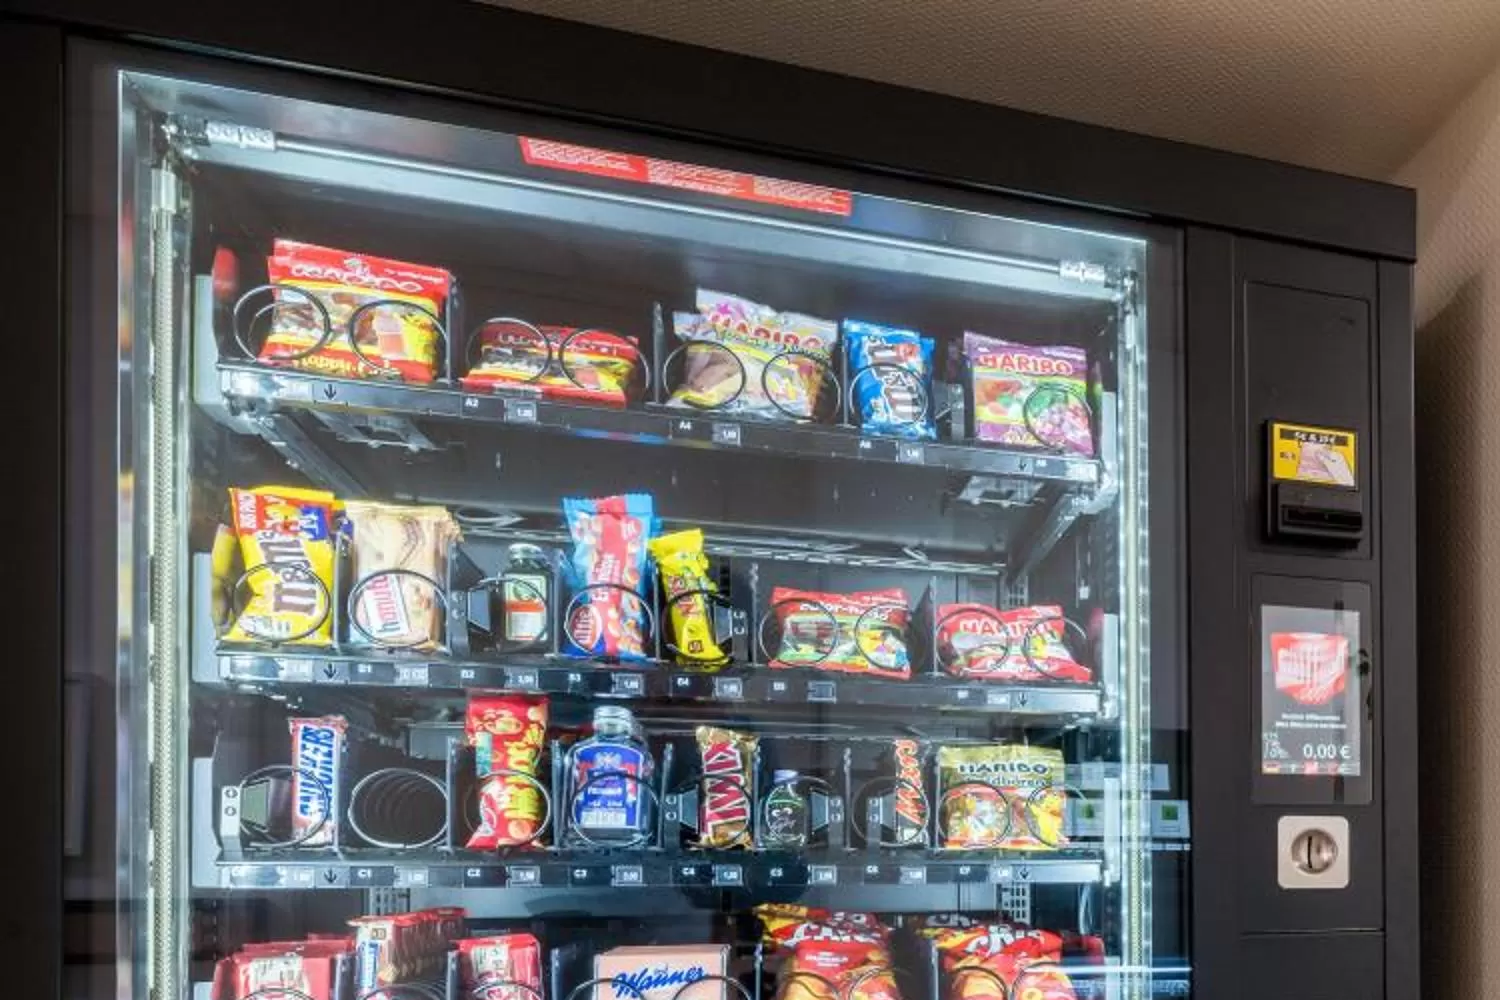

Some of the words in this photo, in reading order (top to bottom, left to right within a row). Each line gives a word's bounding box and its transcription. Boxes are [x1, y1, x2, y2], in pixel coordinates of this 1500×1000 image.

[978, 353, 1073, 375] HARIBO
[299, 725, 335, 822] SNICKERS
[958, 763, 1049, 775] HARIBO
[702, 741, 750, 838] TWIX
[611, 966, 707, 999] Manner
